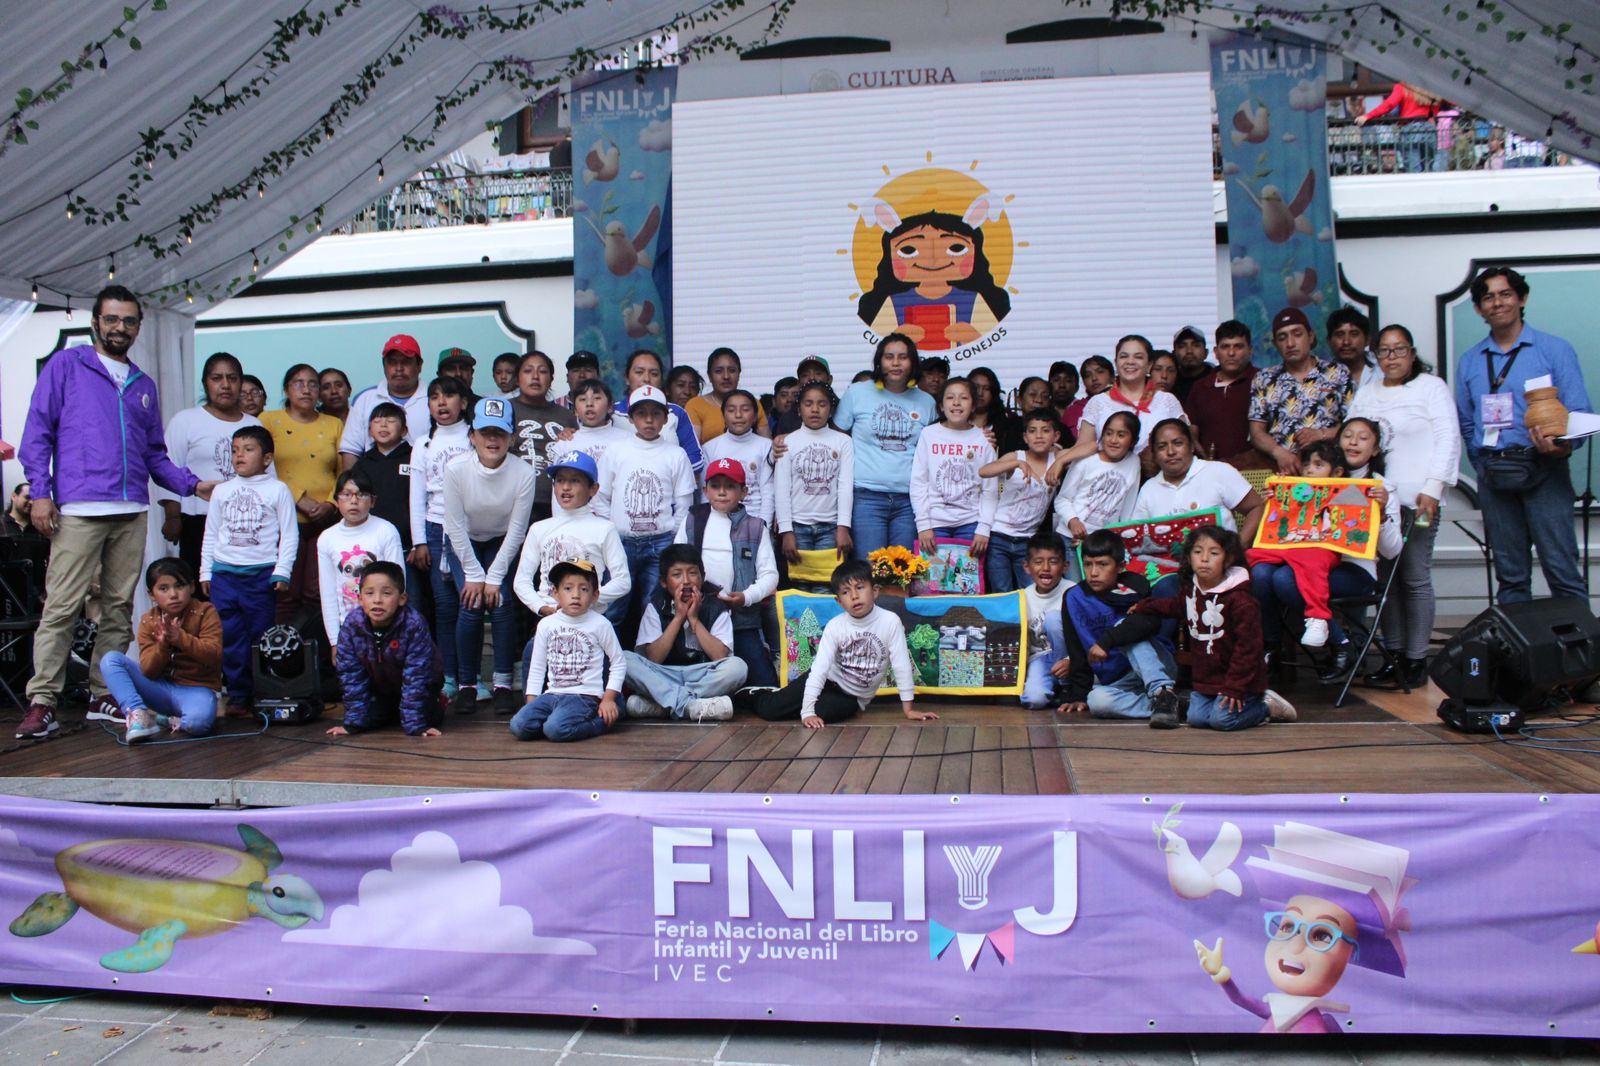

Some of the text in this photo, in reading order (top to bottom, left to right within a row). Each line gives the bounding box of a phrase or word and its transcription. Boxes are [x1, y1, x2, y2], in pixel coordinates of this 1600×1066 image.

[848, 67, 956, 88] CULTURA
[954, 326, 1008, 362] CONEJOS
[932, 443, 963, 456] OVER
[654, 920, 919, 943] Feria Nacional del Libro
[654, 940, 838, 963] Infantil y Juvenil
